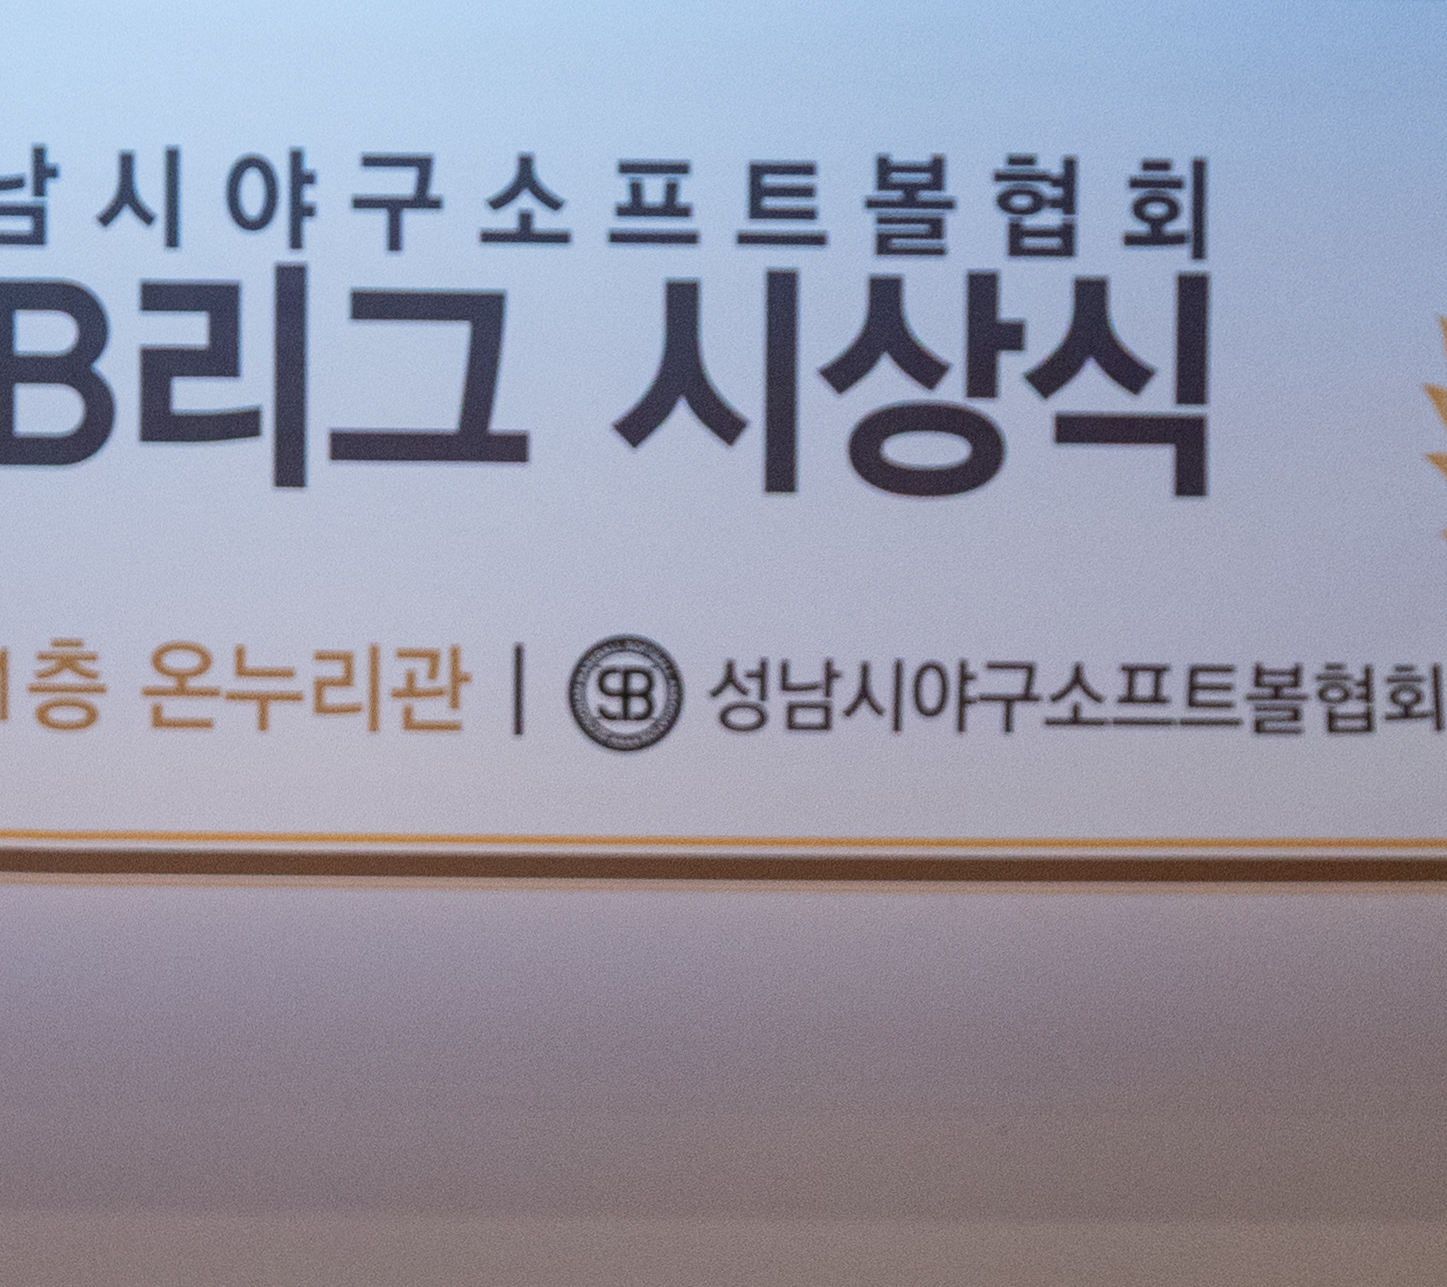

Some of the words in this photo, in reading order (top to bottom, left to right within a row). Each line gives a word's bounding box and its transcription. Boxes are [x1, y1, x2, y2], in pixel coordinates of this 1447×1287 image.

[610, 268, 1212, 498] 시상식
[140, 639, 473, 734] 온누리관
[709, 657, 1447, 734] 성남시야구소프트볼협회
